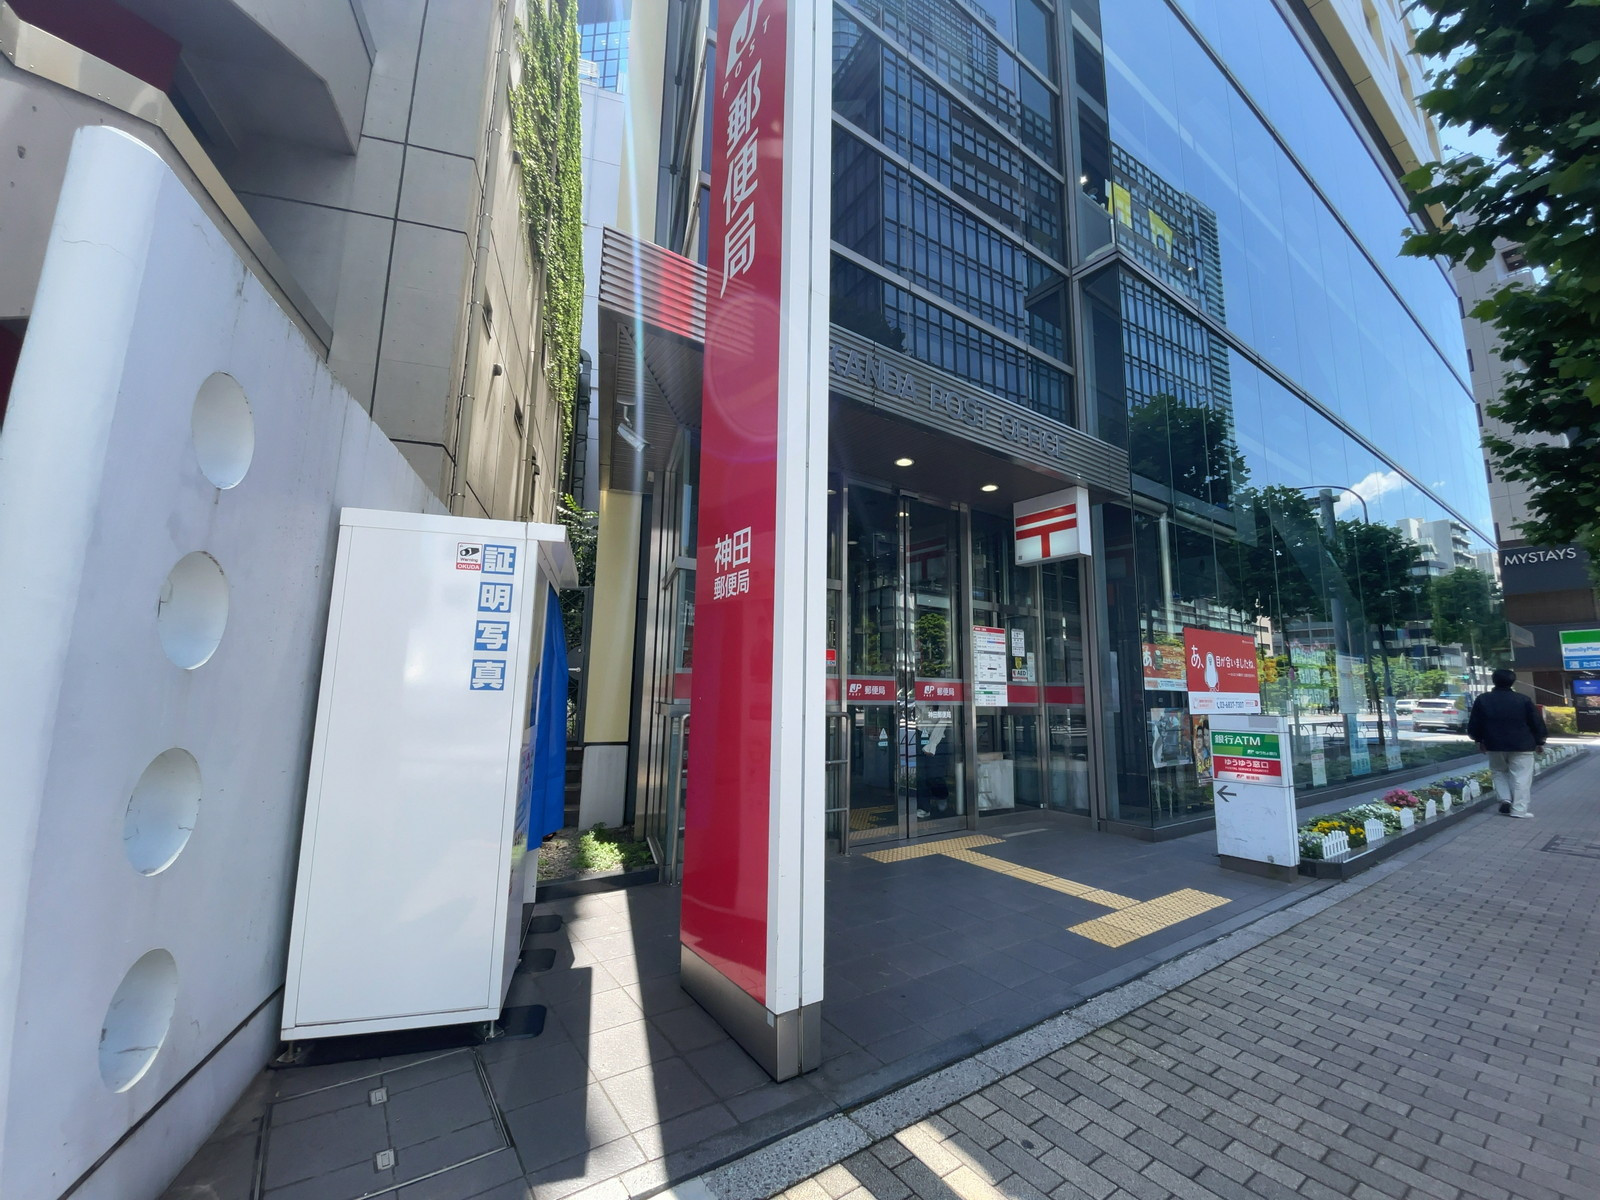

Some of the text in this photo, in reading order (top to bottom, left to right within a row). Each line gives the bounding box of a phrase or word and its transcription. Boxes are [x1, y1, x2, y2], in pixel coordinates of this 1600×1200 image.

[720, 58, 762, 299] 郵便局
[930, 383, 991, 430] POST
[1000, 414, 1068, 459] OFFICE
[714, 526, 751, 574] 神田
[1504, 547, 1577, 566] MYSTAYS
[713, 568, 750, 600] 郵便局
[470, 544, 517, 690] 証明写真
[1191, 644, 1205, 669] あ、
[865, 686, 885, 695] 郵便局
[936, 687, 955, 696] 郵便局
[928, 710, 952, 719] 神田郵便局
[1214, 734, 1261, 746] 銀行ATM
[1224, 758, 1269, 769] ゆうゆう窓口
